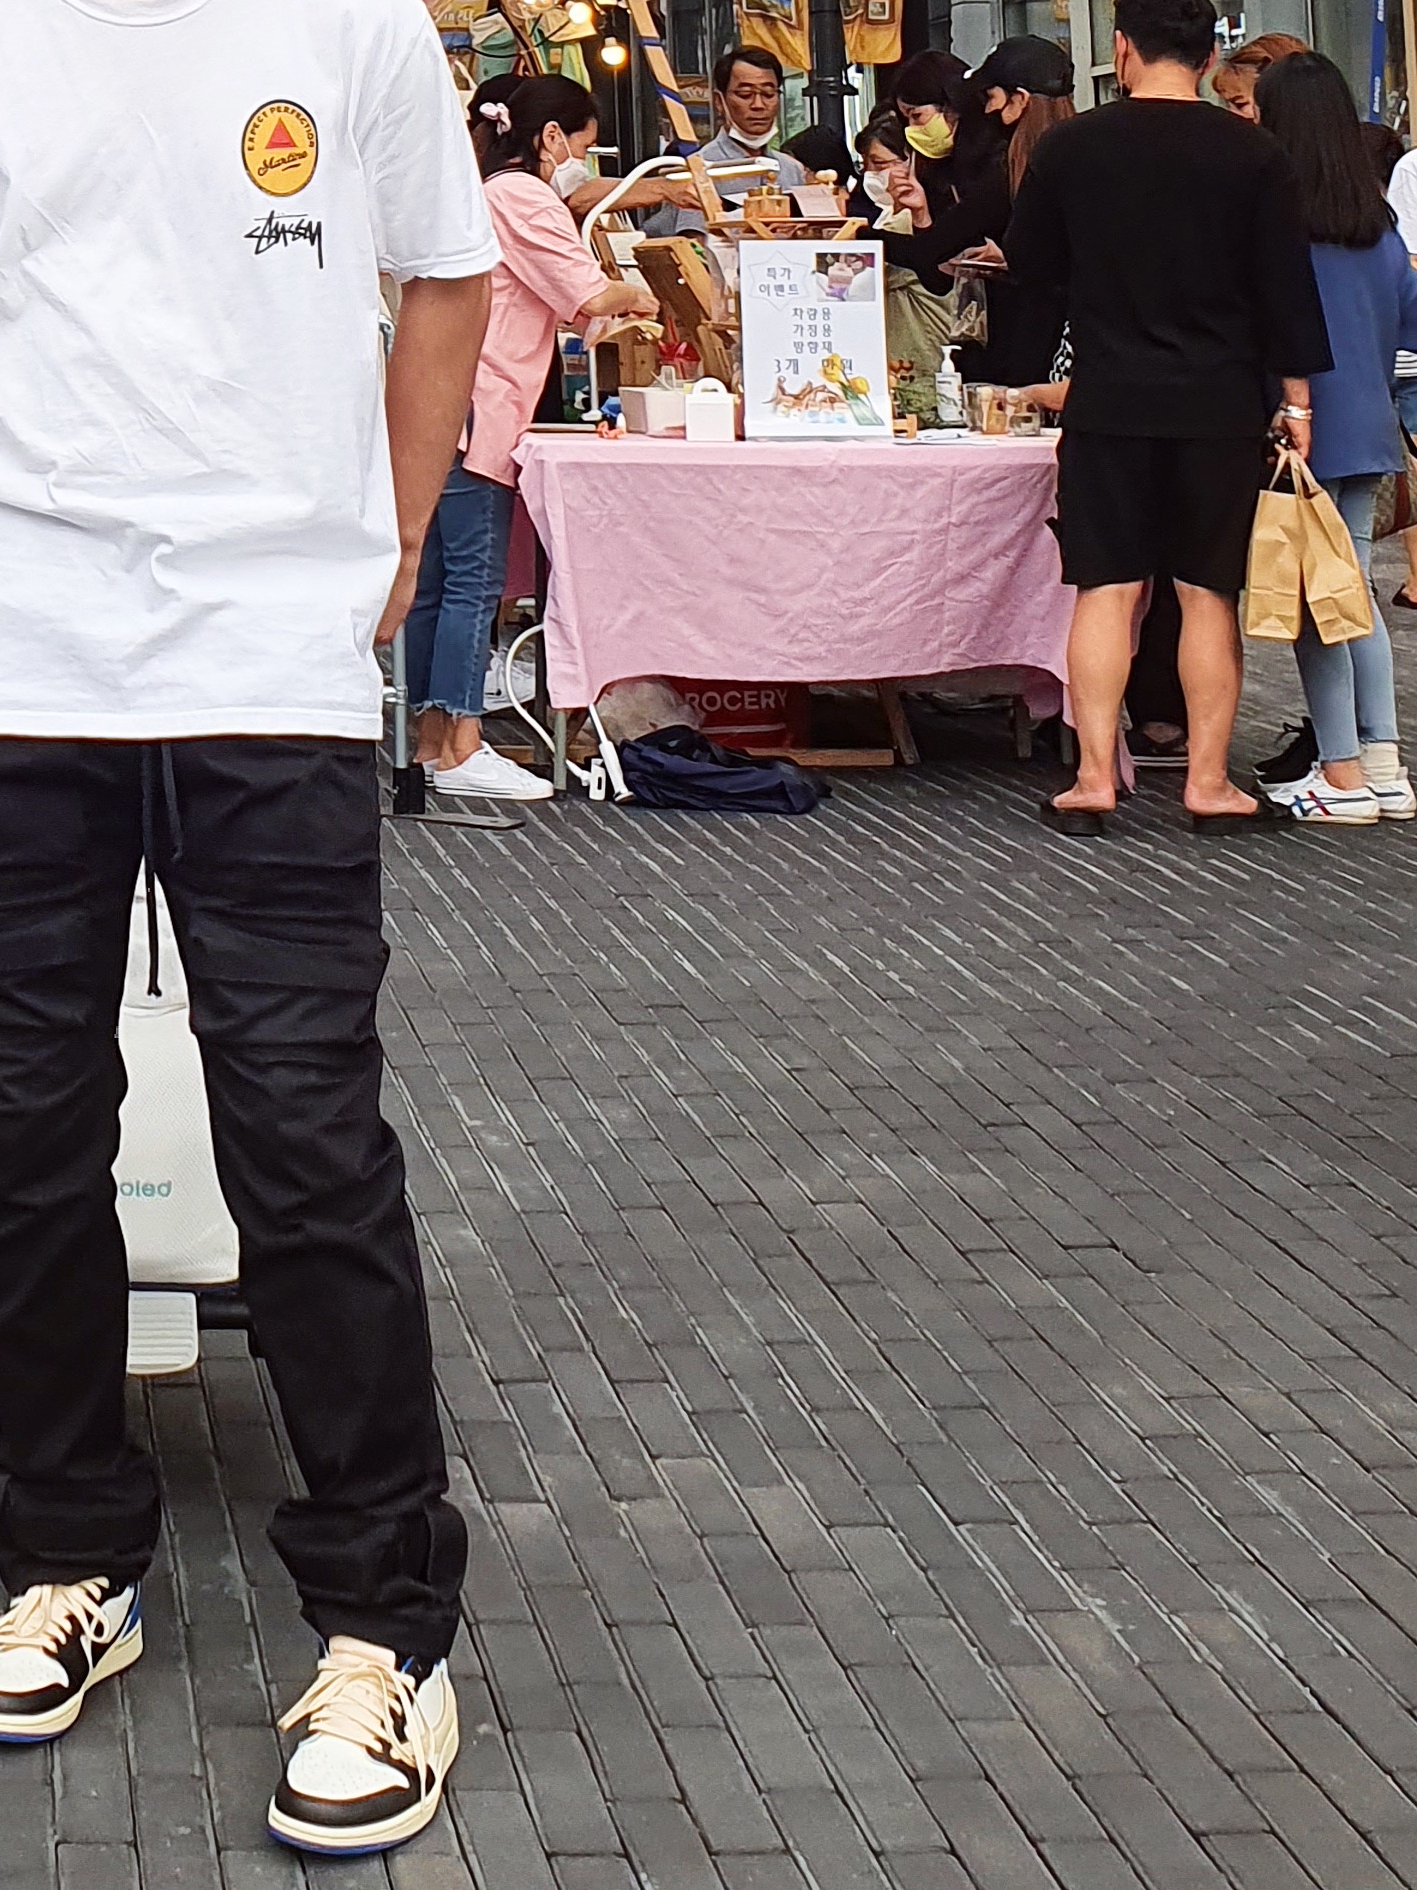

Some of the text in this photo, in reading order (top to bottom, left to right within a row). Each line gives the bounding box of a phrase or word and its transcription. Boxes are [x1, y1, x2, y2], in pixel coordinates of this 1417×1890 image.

[765, 266, 793, 281] 특가
[758, 282, 801, 298] 이벤트
[792, 324, 833, 338] 가정용
[773, 358, 800, 375] 3개
[684, 689, 788, 713] ROCERY
[119, 1180, 173, 1198] oled
